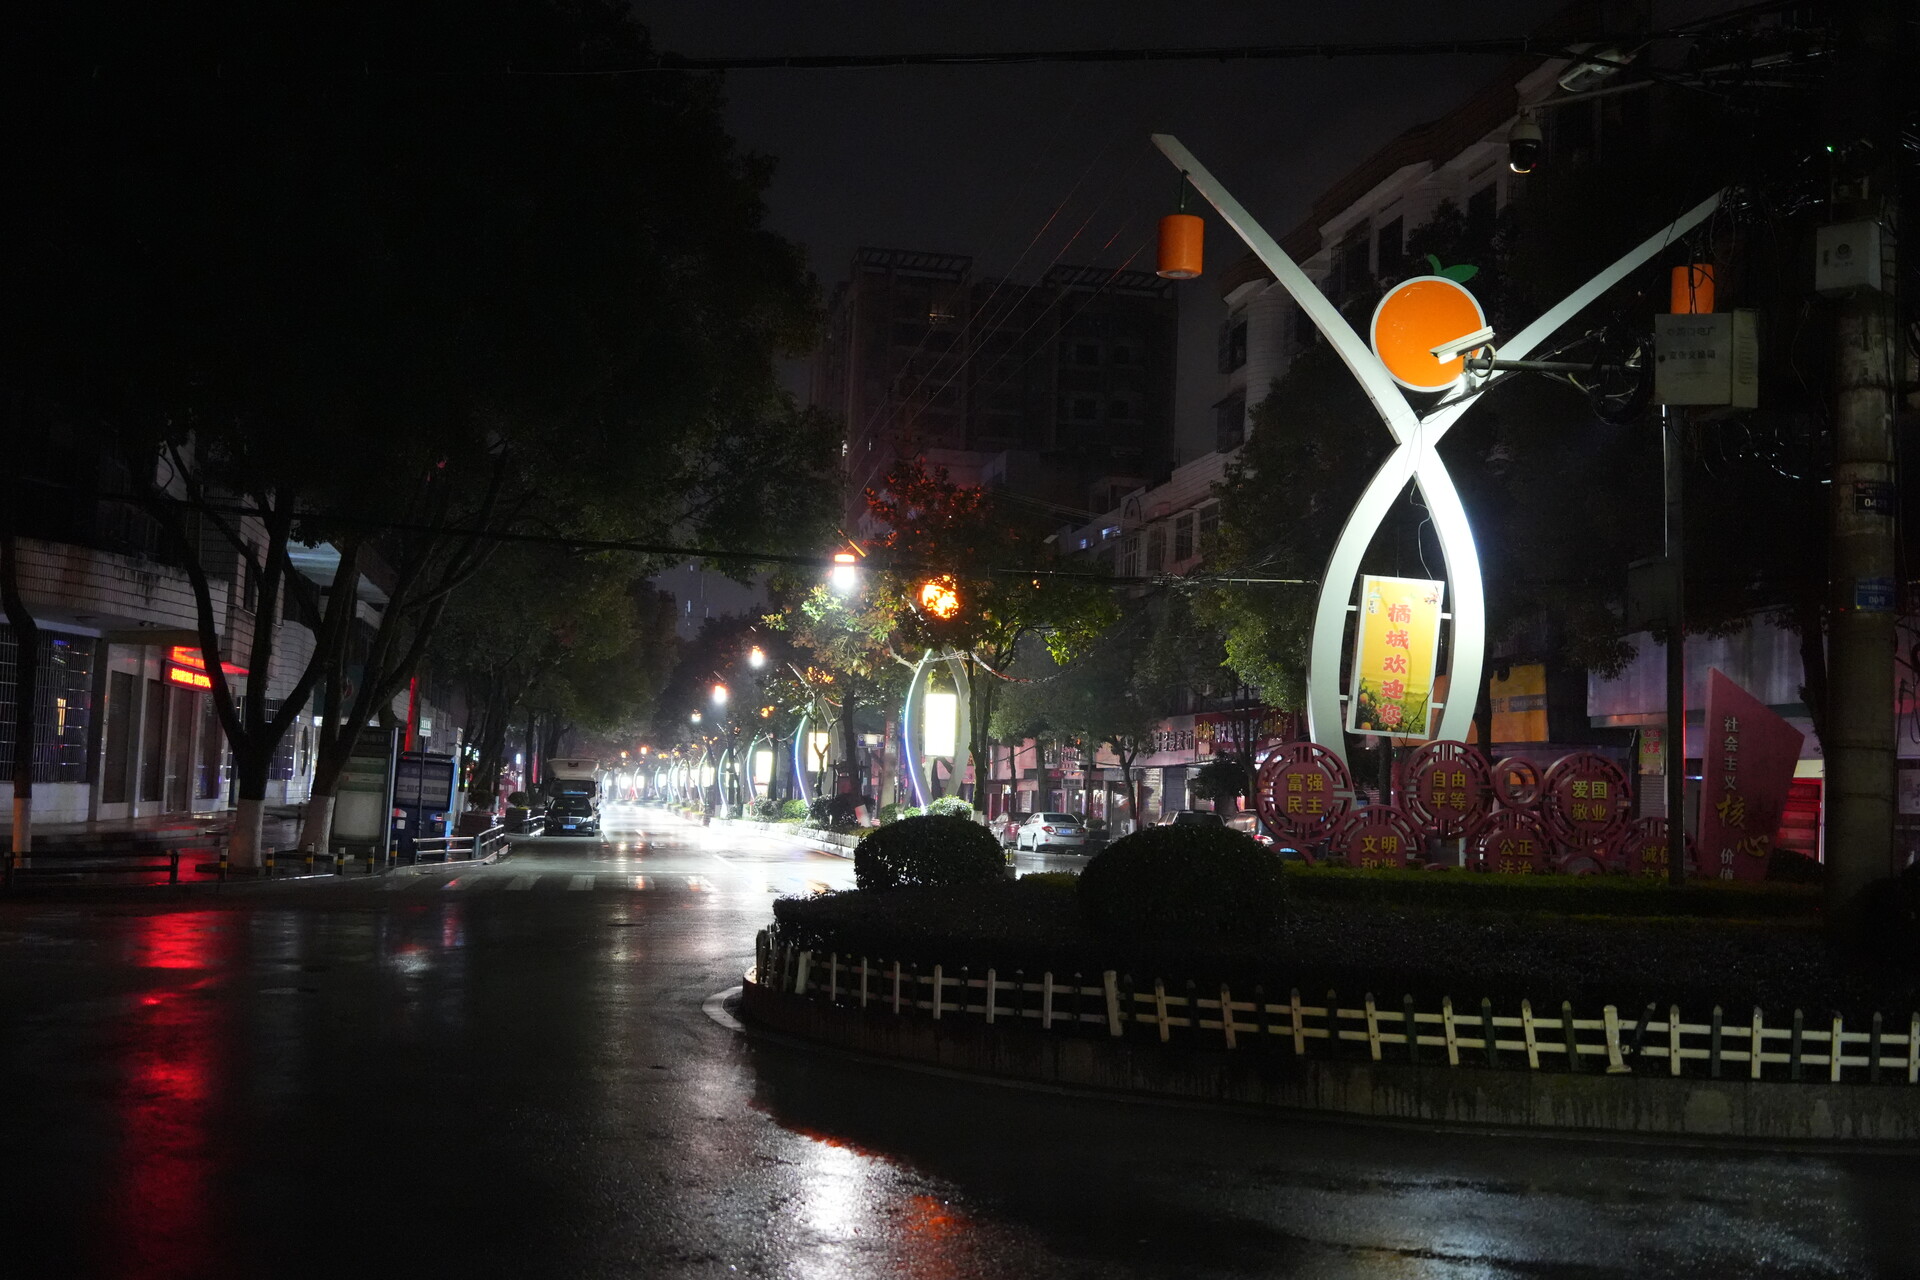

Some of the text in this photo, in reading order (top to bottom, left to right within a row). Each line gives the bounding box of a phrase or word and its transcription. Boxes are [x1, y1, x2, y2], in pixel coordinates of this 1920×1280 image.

[1379, 603, 1411, 725] 橘城欢迎您
[1286, 773, 1325, 792] 富强
[1431, 769, 1466, 788] 自由
[1571, 780, 1608, 800] 爱国
[1286, 795, 1325, 815] 民主
[1430, 791, 1467, 811] 平等
[1571, 803, 1608, 821] 敬业
[1361, 834, 1398, 854] 文明
[1498, 838, 1534, 857] 公正
